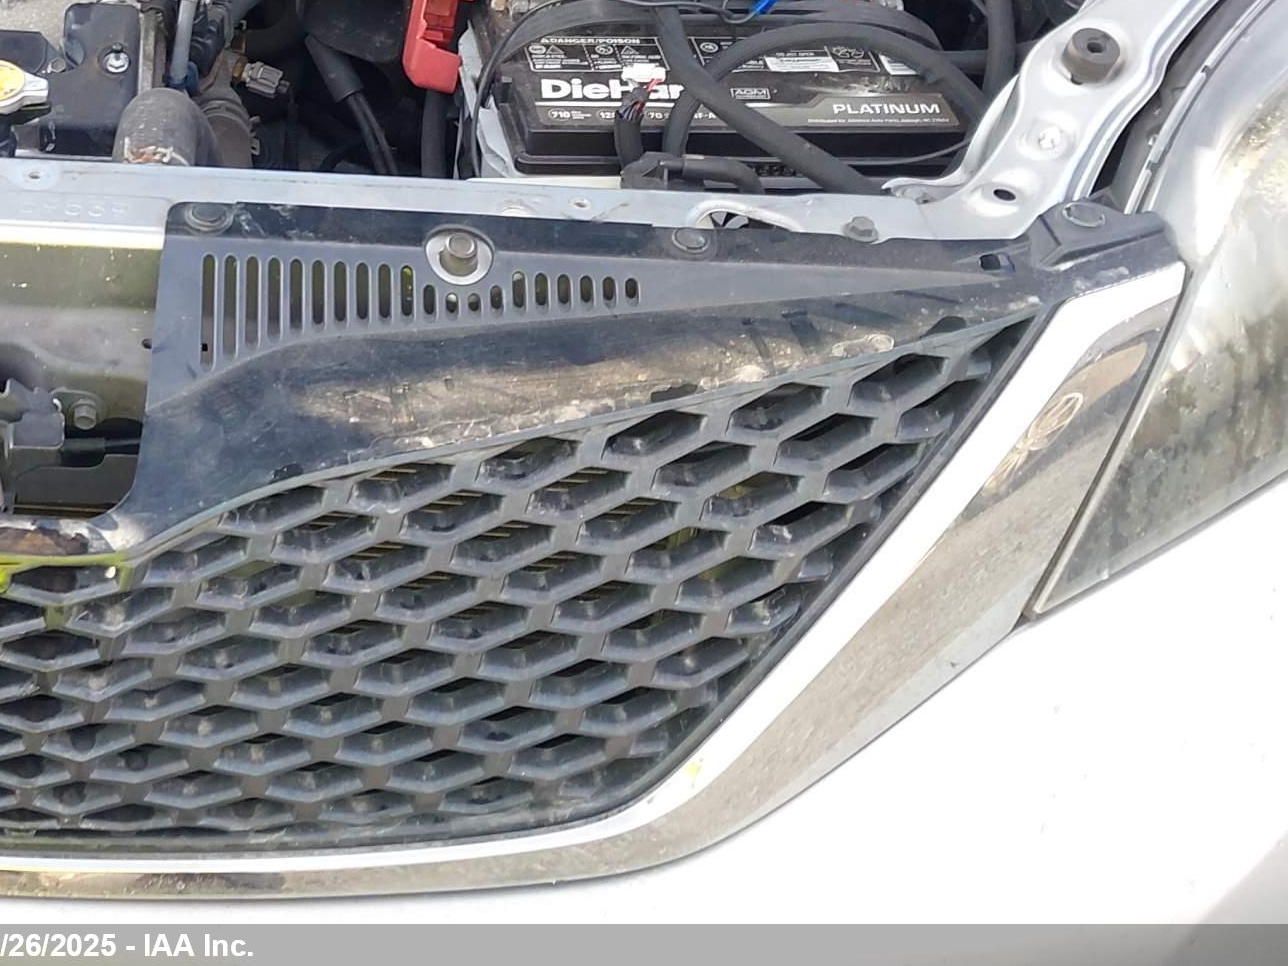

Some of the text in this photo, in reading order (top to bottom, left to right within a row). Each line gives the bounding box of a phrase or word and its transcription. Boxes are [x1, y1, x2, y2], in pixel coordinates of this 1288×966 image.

[540, 78, 684, 100] DieHar
[551, 111, 571, 119] 710
[833, 103, 941, 115] PLATINUM
